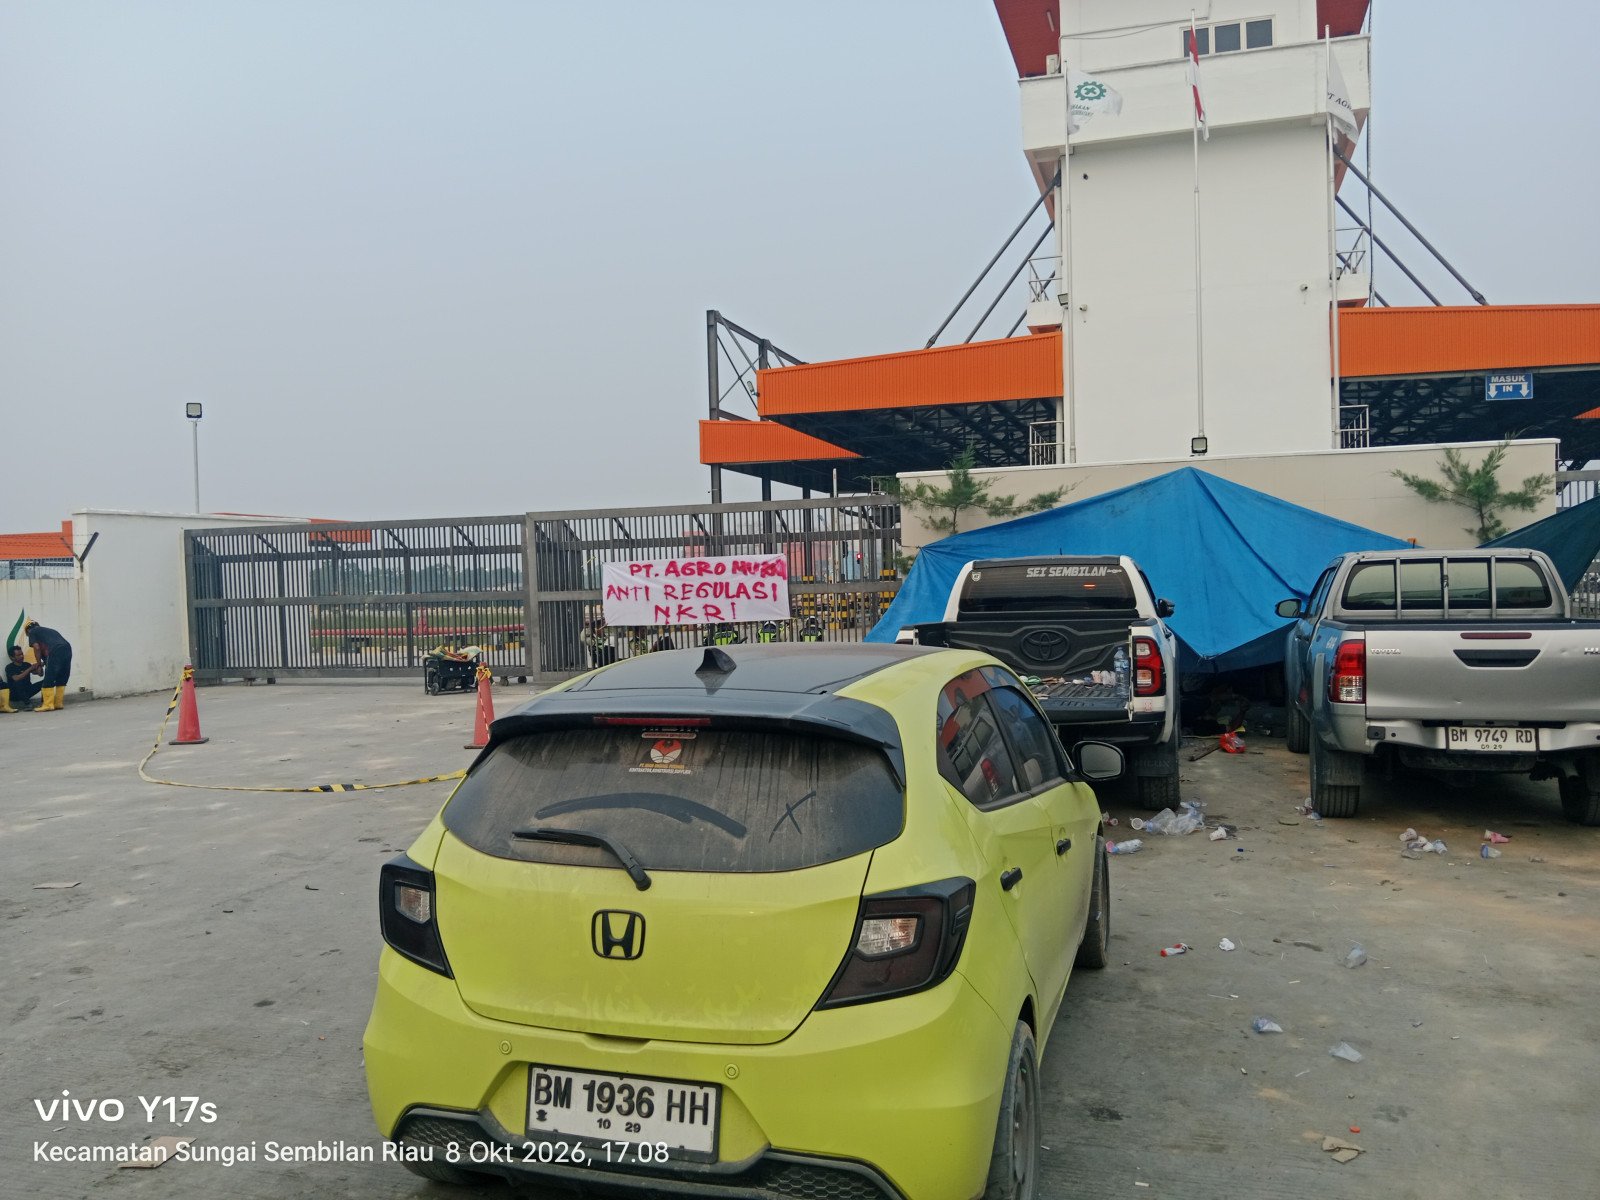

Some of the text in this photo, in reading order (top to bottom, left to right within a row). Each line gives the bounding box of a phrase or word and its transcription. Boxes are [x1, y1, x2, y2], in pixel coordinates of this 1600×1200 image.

[1491, 375, 1526, 383] MASUK
[1502, 385, 1513, 393] IN
[629, 563, 660, 578] PT.
[665, 560, 726, 577] AGRO
[1026, 568, 1046, 578] SEI
[1049, 566, 1107, 578] SEMBILAN
[606, 581, 777, 602] ANTI REGULASI
[654, 602, 736, 625] NKRI
[1451, 728, 1533, 743] BM 9749 RD
[534, 1073, 709, 1126] BM 1936 HH
[596, 1118, 642, 1133] 10 29
